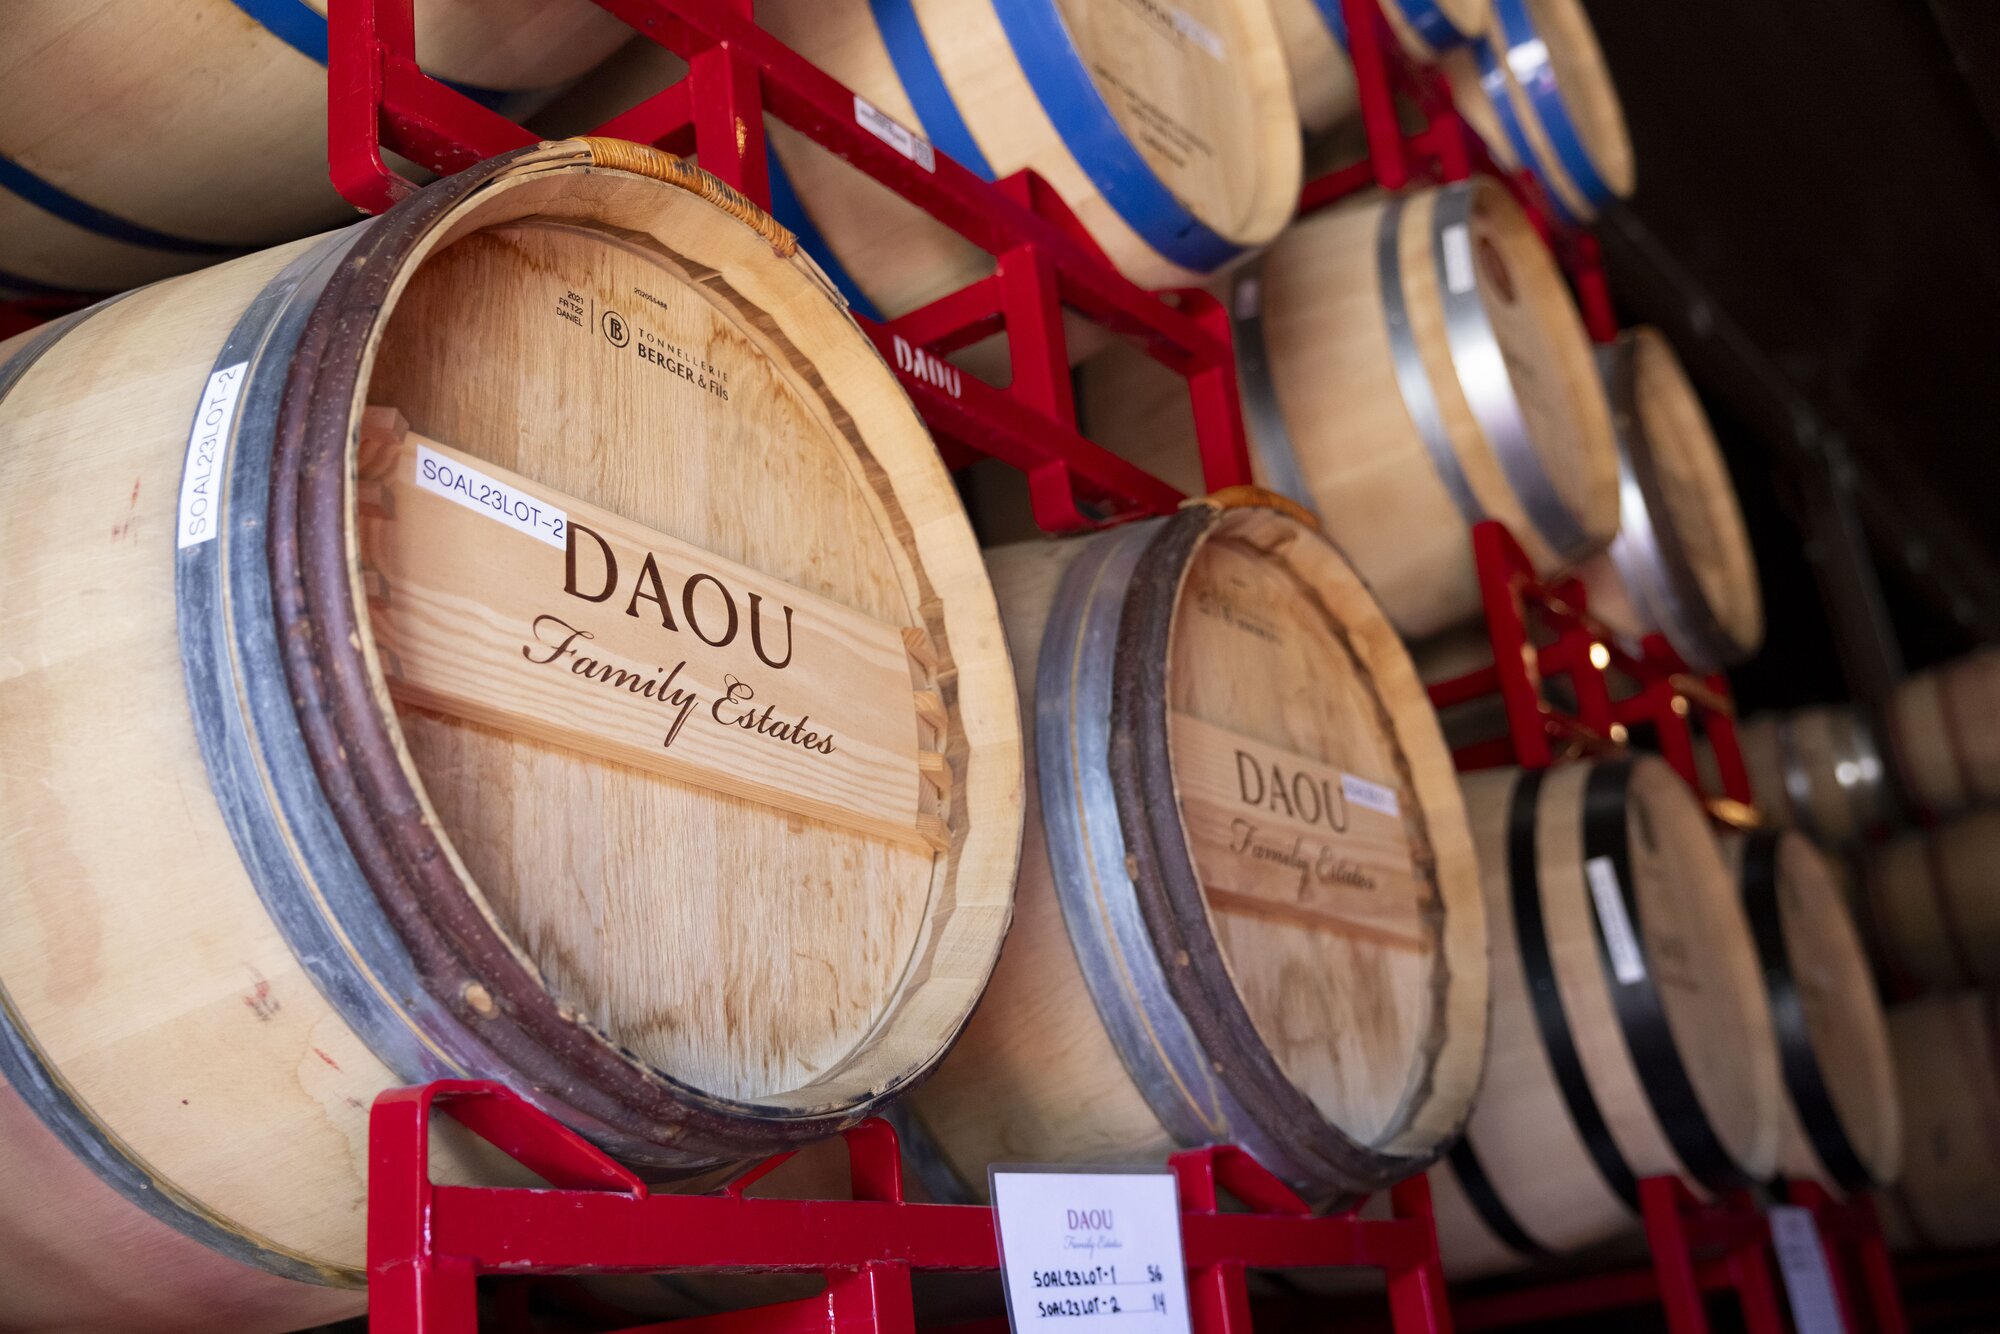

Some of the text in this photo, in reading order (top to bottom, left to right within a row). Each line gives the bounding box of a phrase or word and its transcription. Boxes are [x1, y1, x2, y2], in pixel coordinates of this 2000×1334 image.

[556, 306, 583, 327] DANIEL
[558, 297, 584, 316] FR T22
[567, 291, 584, 305] 2021
[637, 342, 729, 401] BERGER & Fils
[638, 327, 728, 382] TONNELLERIE
[893, 334, 961, 399] DAOU
[189, 369, 236, 536] SOAL23LOT-2
[422, 458, 564, 539] SOAL23LOT-2
[563, 521, 794, 670] DAOU
[522, 614, 837, 754] Family Estates
[1234, 750, 1347, 834] DAOU
[1229, 816, 1310, 902] Family
[1067, 1209, 1113, 1231] DAOU
